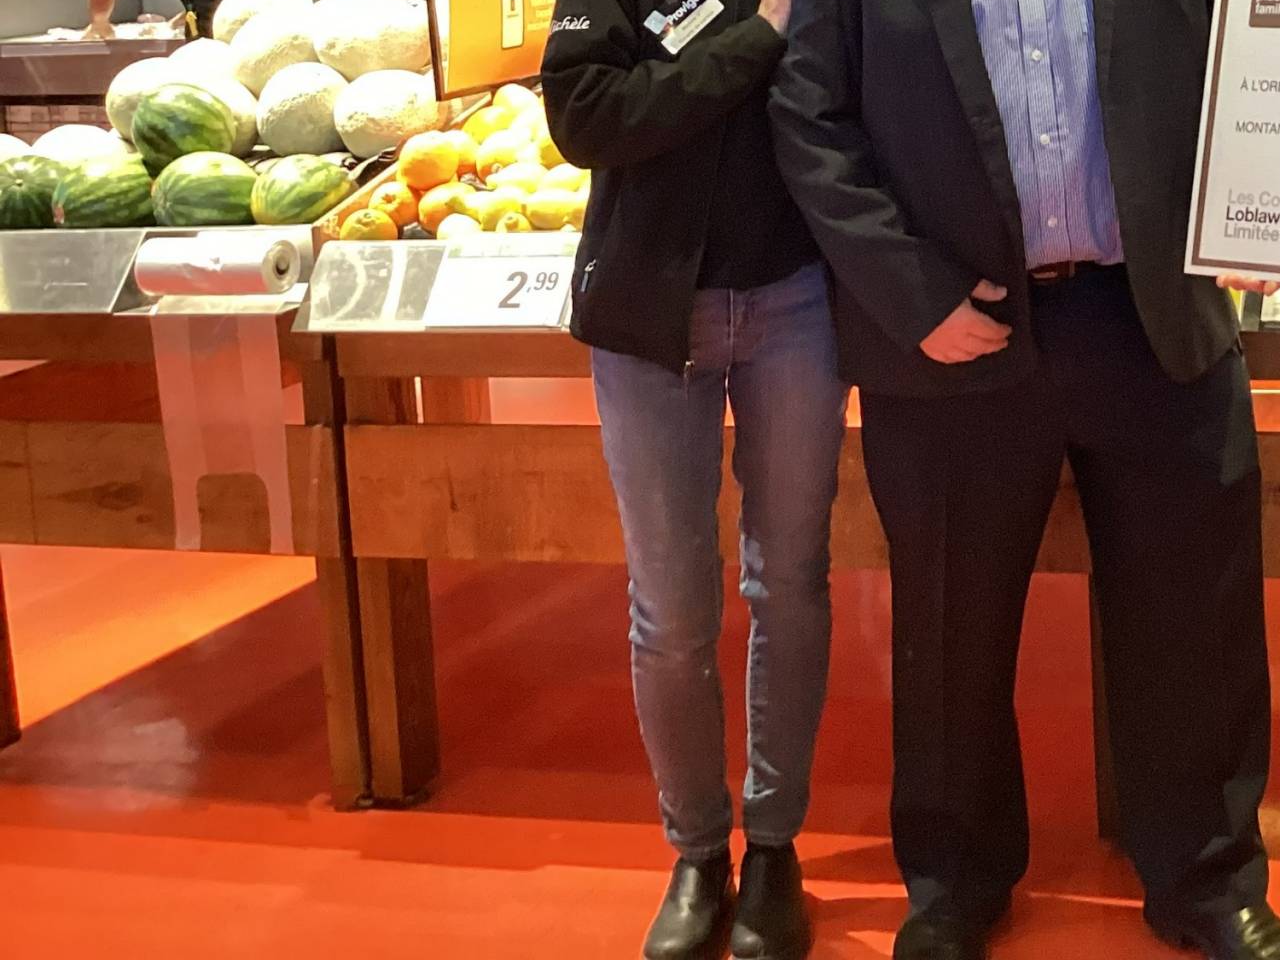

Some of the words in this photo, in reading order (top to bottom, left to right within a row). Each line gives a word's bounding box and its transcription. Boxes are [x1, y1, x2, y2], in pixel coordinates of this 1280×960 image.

[1240, 76, 1250, 92] À
[1227, 187, 1255, 206] Les
[1226, 205, 1280, 224] Loblaw
[1223, 221, 1280, 241] Limitée
[498, 270, 560, 309] 2,99
